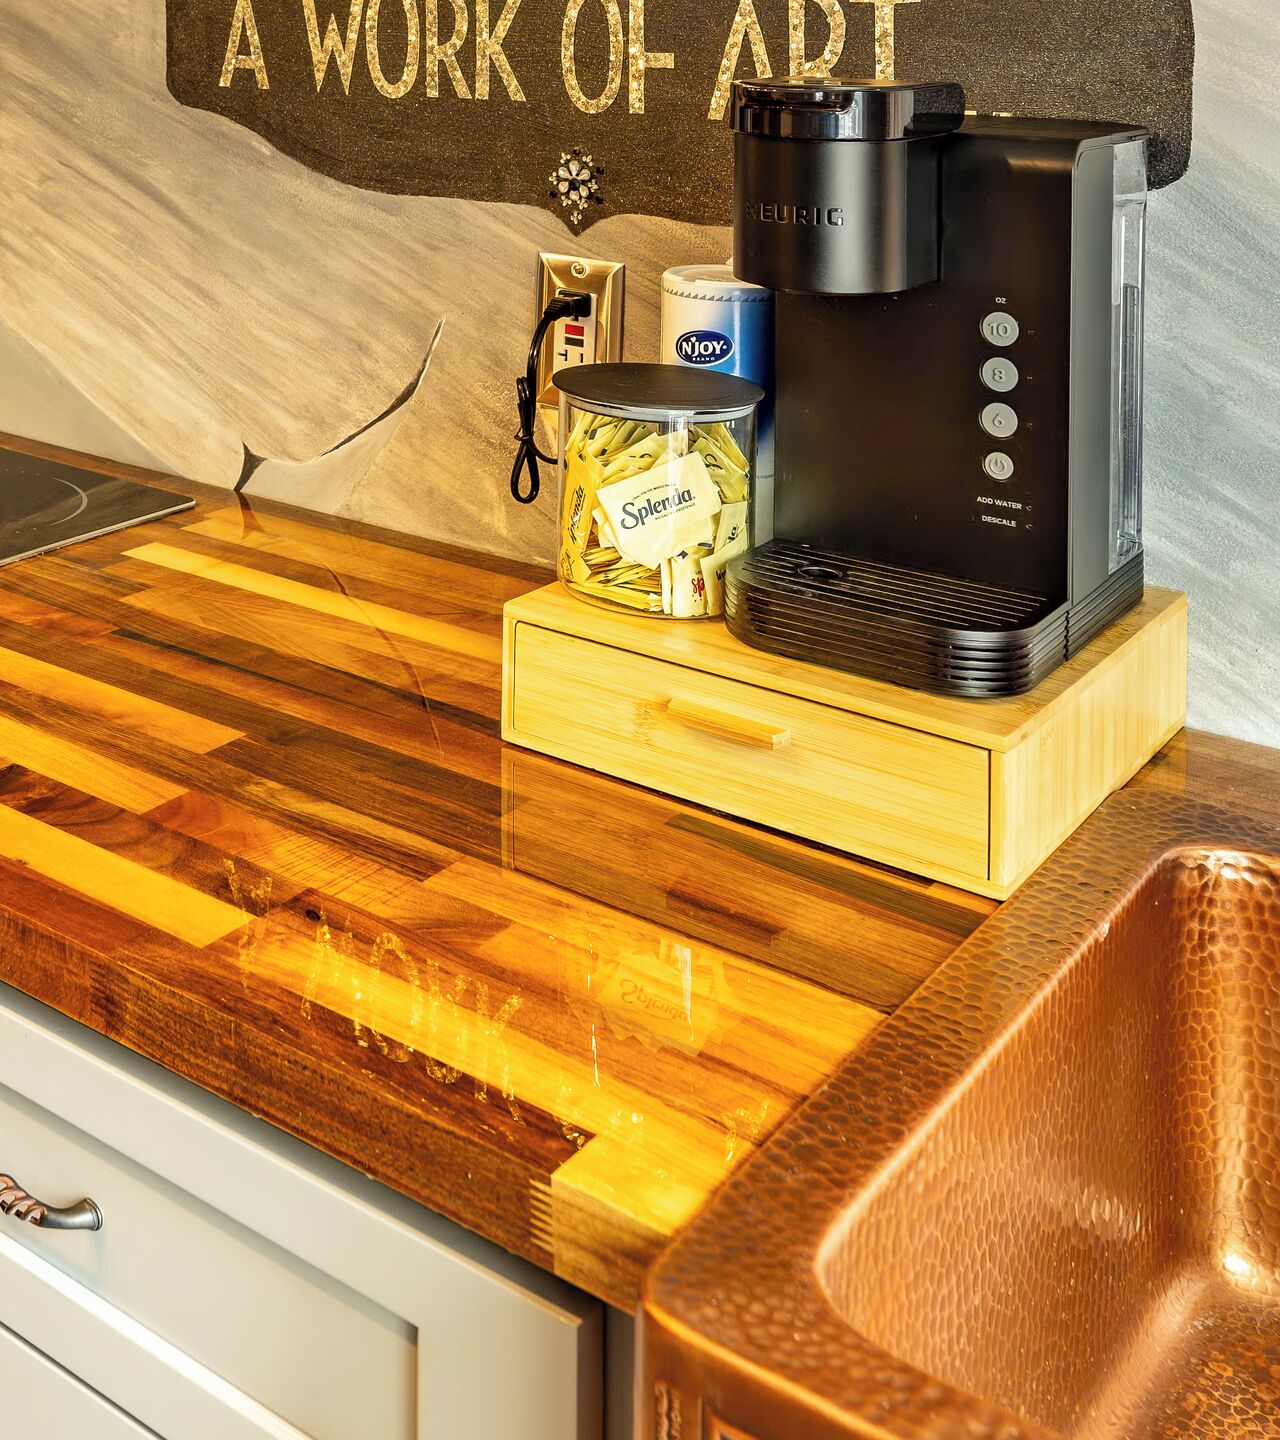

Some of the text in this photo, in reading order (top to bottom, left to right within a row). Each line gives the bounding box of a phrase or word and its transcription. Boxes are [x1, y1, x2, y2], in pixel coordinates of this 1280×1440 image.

[995, 296, 1007, 304] OZ
[988, 321, 1011, 338] 10
[992, 367, 1006, 383] 8
[992, 412, 1006, 428] 6
[621, 487, 693, 530] Splenda
[976, 496, 1022, 510] ADD WATER
[981, 515, 1017, 528] DESCALE
